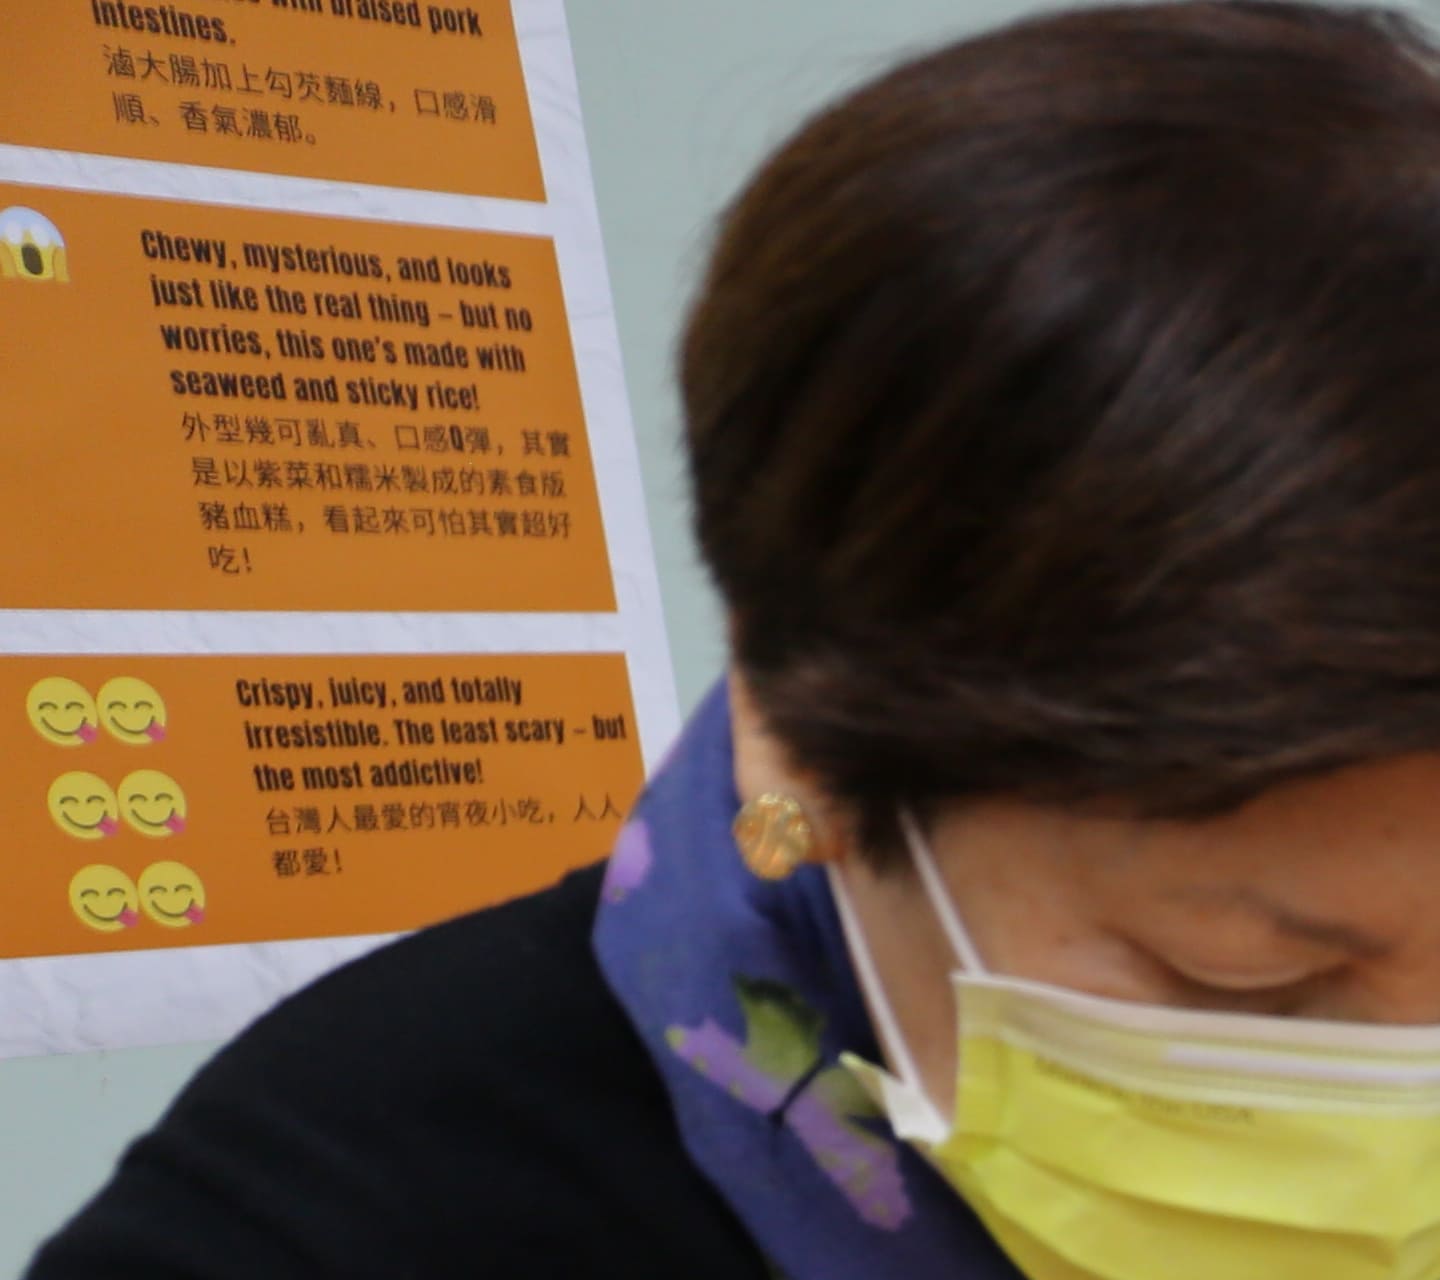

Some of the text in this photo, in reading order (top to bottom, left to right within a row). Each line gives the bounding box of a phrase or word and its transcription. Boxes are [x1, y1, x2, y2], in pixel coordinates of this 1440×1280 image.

[427, 7, 482, 36] pork
[141, 229, 512, 289] Chewy, mysterious, and looks
[150, 273, 203, 308] just
[209, 279, 259, 311] like
[265, 285, 307, 316] the
[314, 291, 361, 319] real
[368, 293, 430, 328] thing
[460, 300, 498, 329] but
[504, 307, 532, 332] no
[160, 323, 526, 372] worries, this one's made with
[170, 370, 480, 411] seaweed and sticky rice!
[235, 676, 522, 709] Crispy, juicy, and totally
[244, 719, 388, 750] irresistible.
[394, 718, 434, 746] The
[441, 717, 498, 744] least
[505, 718, 564, 745] scary
[592, 713, 626, 740] but
[253, 757, 483, 792] the most addictive!
